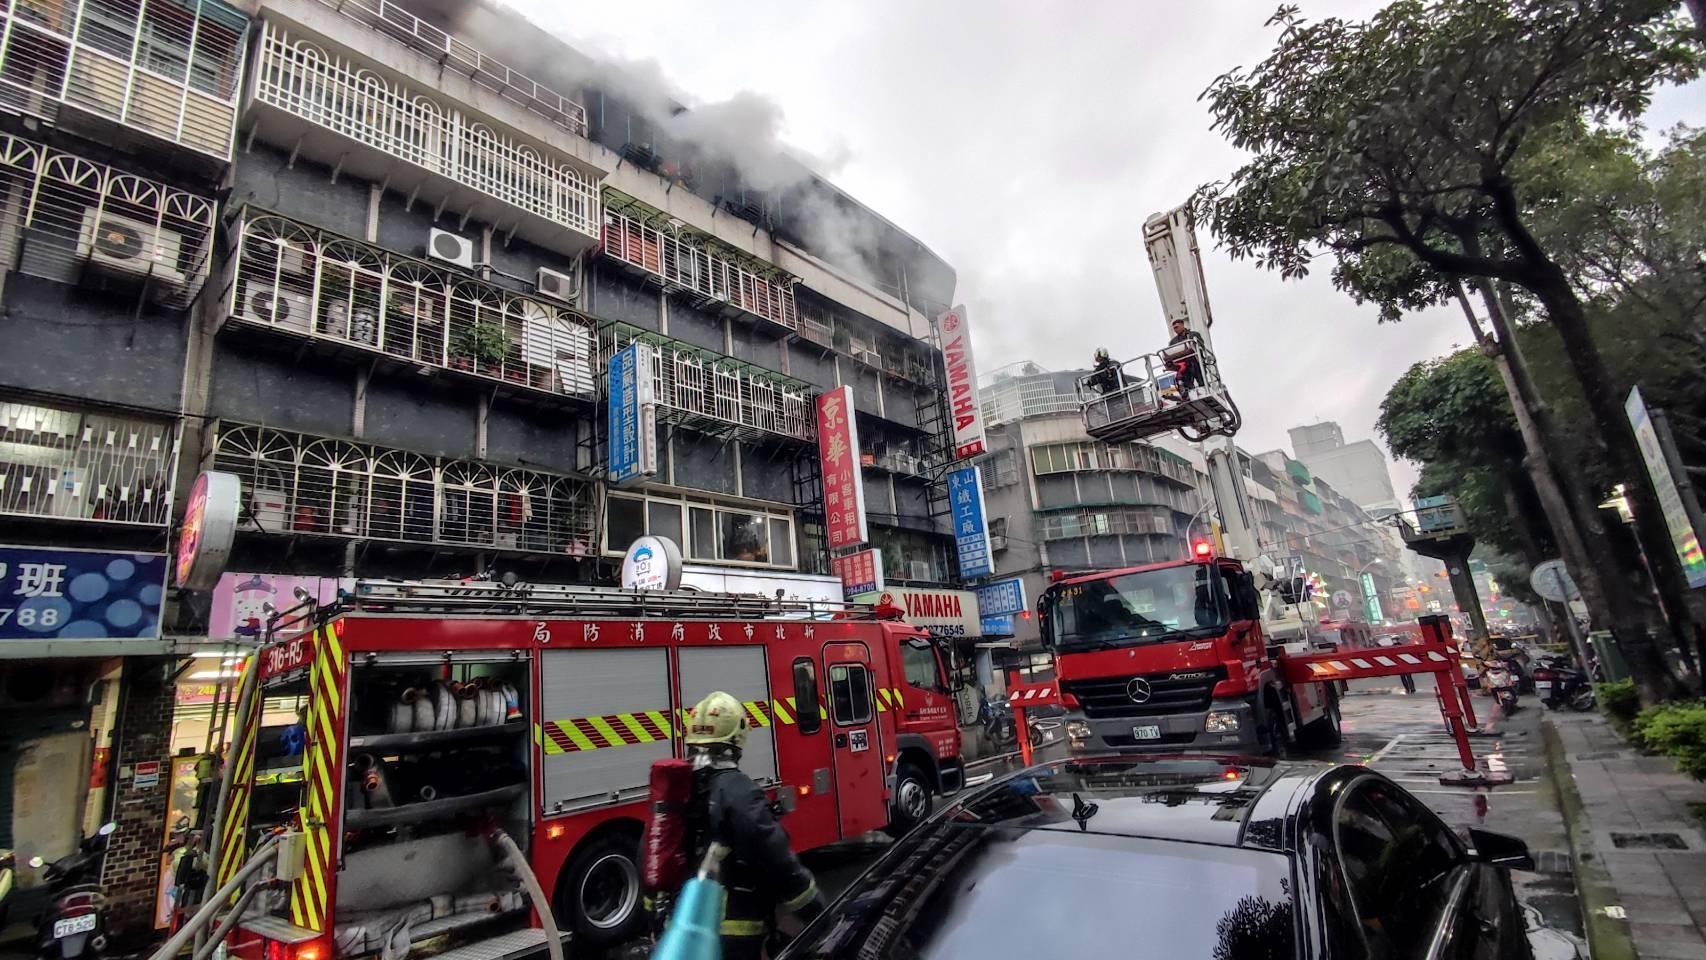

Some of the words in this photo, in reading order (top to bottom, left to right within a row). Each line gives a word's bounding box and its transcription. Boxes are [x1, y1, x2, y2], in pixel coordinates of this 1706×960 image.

[945, 335, 975, 431] YAMAHA
[821, 396, 848, 467] 京華
[826, 473, 843, 544] 有限公司
[902, 592, 963, 618] YAMAHA
[267, 638, 303, 674] 316-R5
